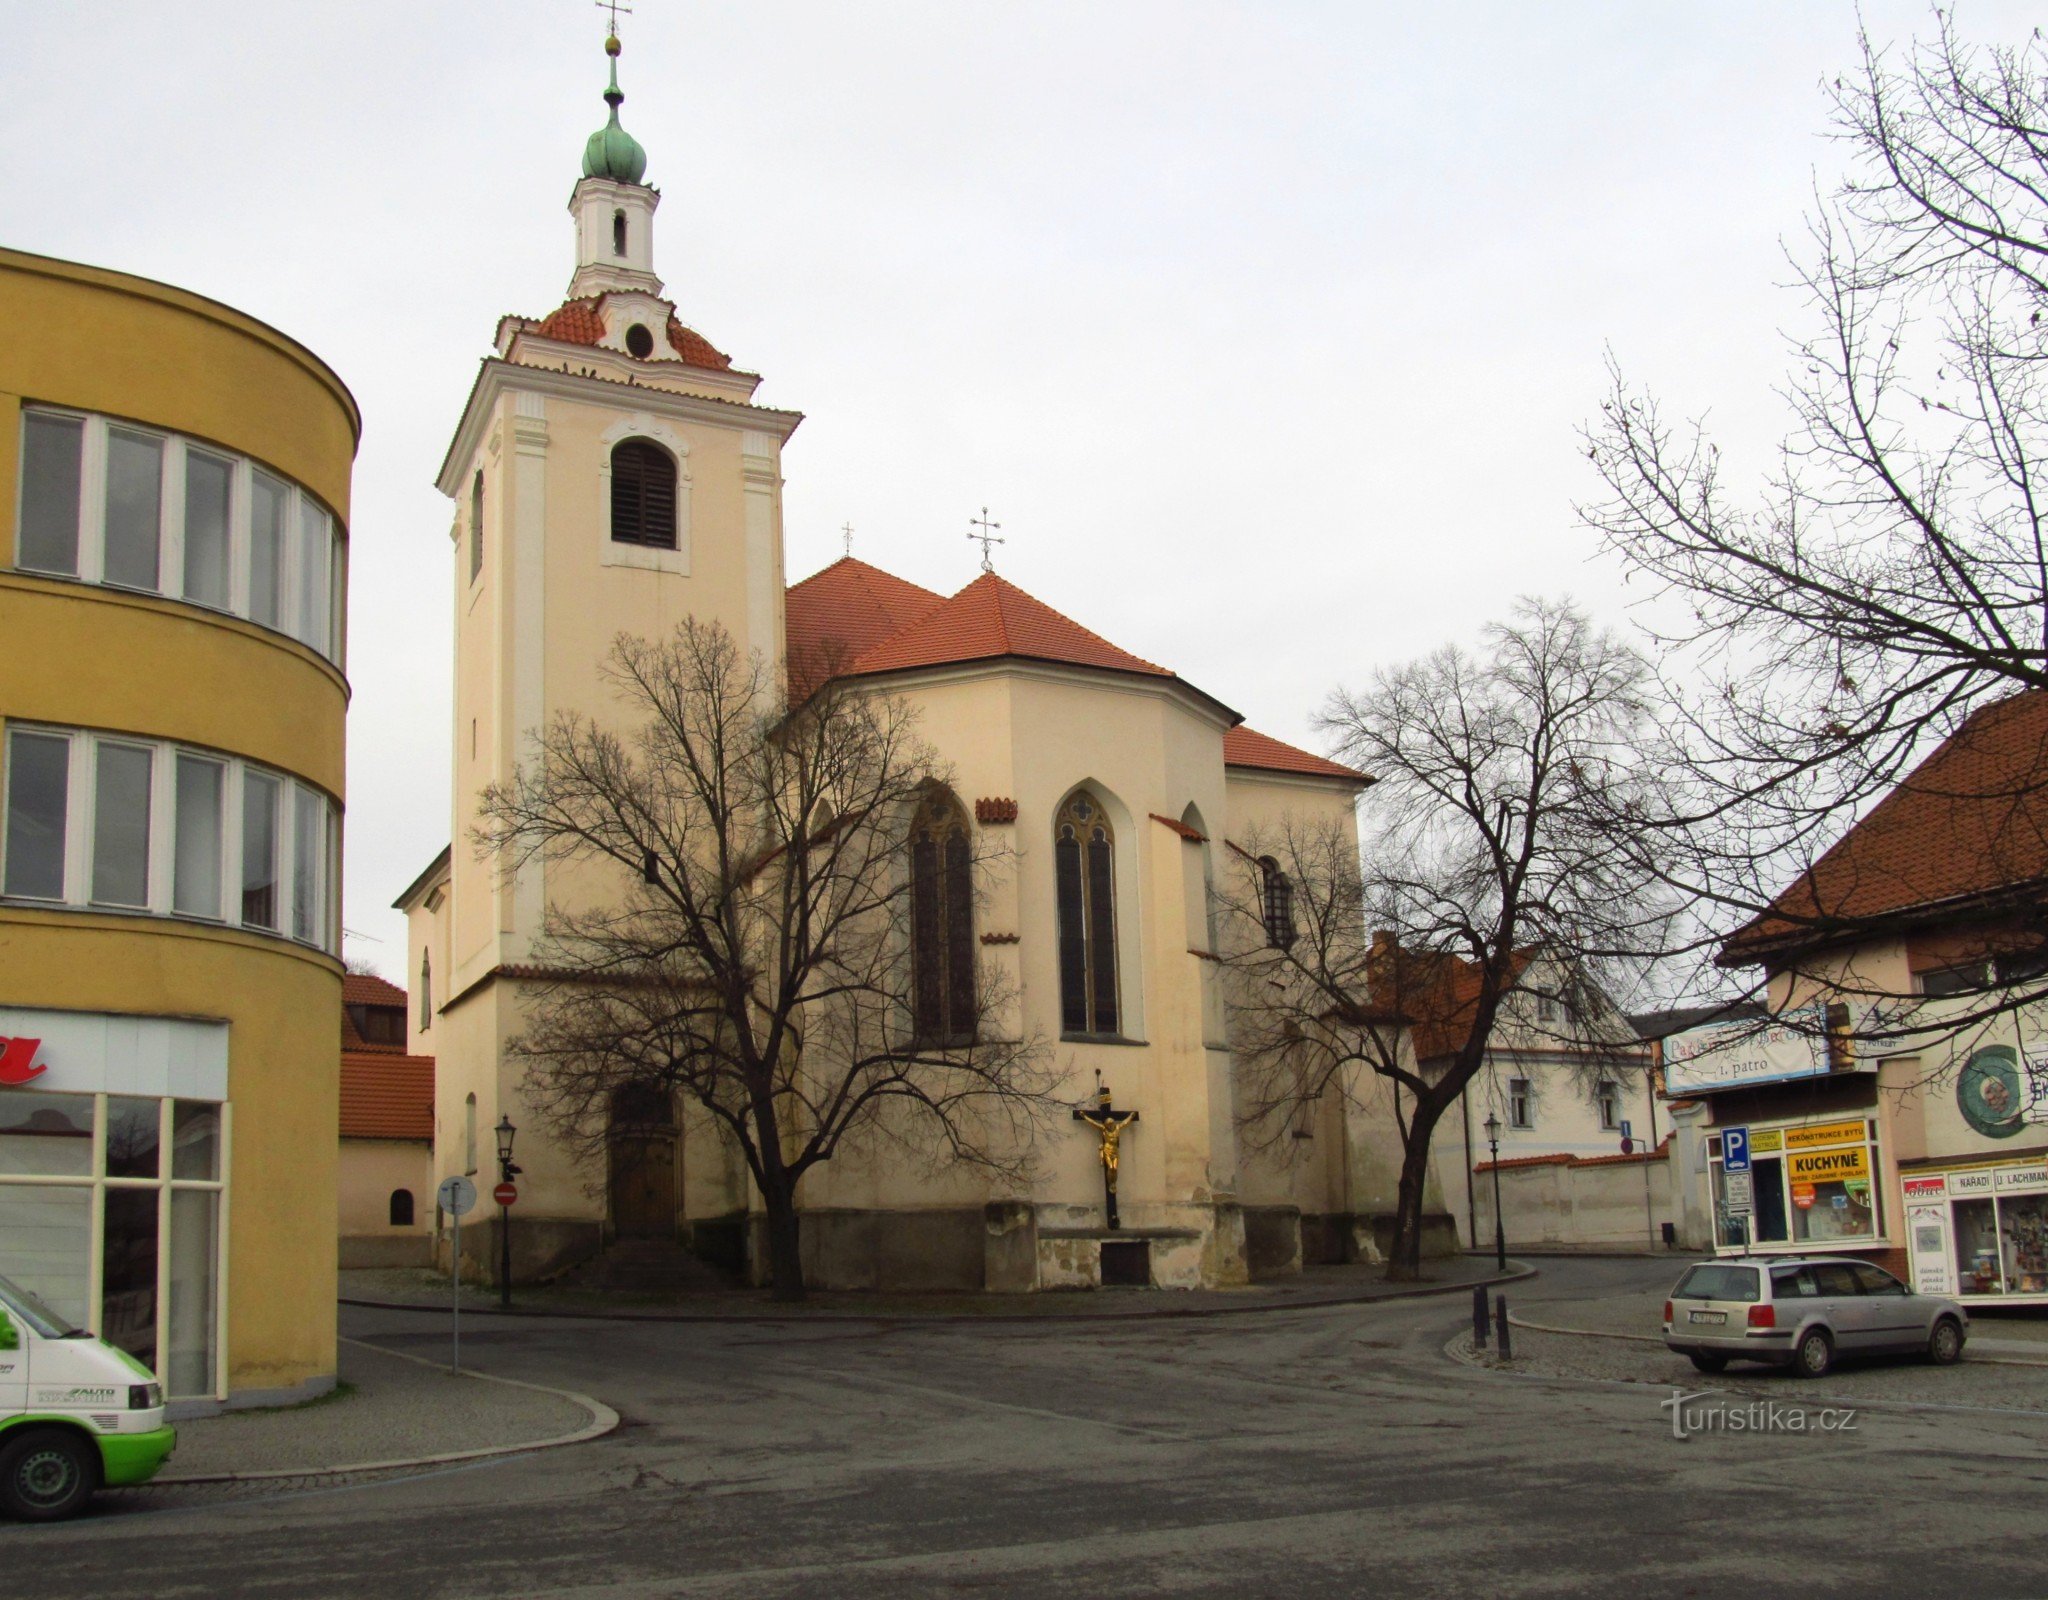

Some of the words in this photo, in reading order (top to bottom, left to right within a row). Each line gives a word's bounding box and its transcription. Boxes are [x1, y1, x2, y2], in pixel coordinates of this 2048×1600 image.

[1732, 1060, 1768, 1079] patro
[1727, 1132, 1743, 1158] P
[1788, 1130, 1842, 1142] REKONSTRUKCE
[1796, 1151, 1859, 1172] KUCHYNĚ
